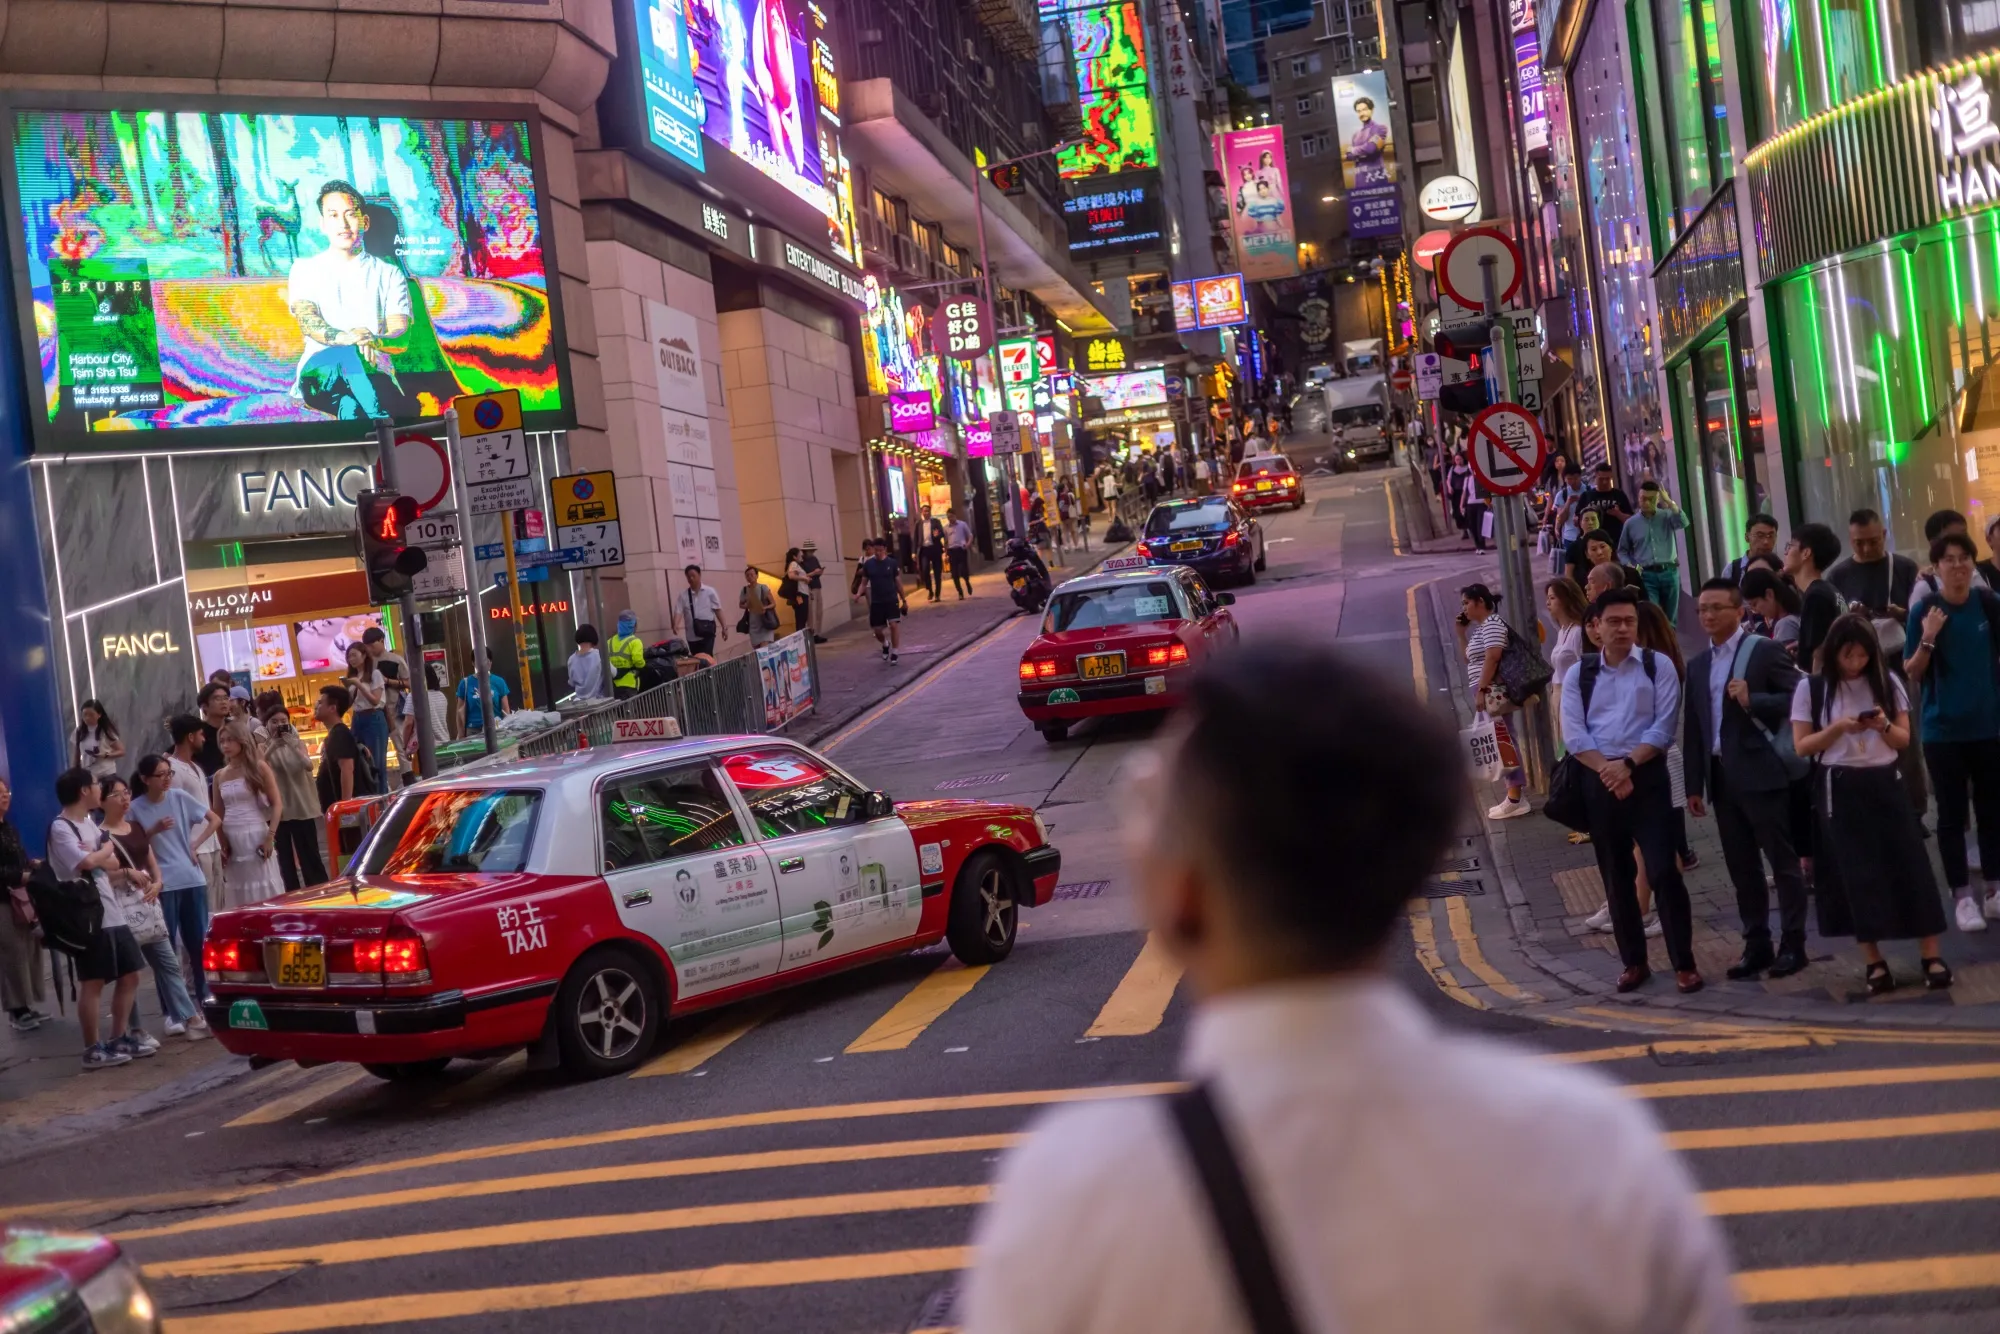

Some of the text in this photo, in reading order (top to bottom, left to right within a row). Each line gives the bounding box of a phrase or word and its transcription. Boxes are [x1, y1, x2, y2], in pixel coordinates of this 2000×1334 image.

[1438, 186, 1459, 195] NCB
[422, 234, 440, 245] Lau
[786, 243, 840, 290] ENTERTAINMENT
[61, 280, 142, 292] ÉPURE
[1444, 322, 1468, 330] Length
[69, 354, 133, 366] Harbour City,
[660, 349, 697, 377] OUTBACK
[71, 366, 137, 378] Tsim Sha Tsui
[74, 396, 115, 405] WhatsApp
[502, 434, 512, 450] 7
[475, 444, 492, 455] 上午
[478, 468, 496, 479] 下午
[480, 459, 516, 475] pm 7
[481, 483, 517, 494] Except taxi
[474, 489, 526, 502] pick up/drop off
[417, 523, 455, 538] 10 m
[596, 525, 606, 539] 7
[600, 547, 618, 562] 12
[1106, 556, 1143, 569] TAXI
[189, 590, 272, 610] ALLOYAU
[204, 608, 230, 619] PARIS
[102, 632, 179, 658] FANCL
[1088, 665, 1119, 677] 4780
[616, 720, 664, 737] TAXI
[1470, 734, 1494, 747] ONE
[1472, 744, 1496, 757] DIM
[497, 901, 542, 930] 的士
[501, 924, 547, 955] TAXI
[283, 964, 321, 983] 9633
[242, 1007, 250, 1019] 4
